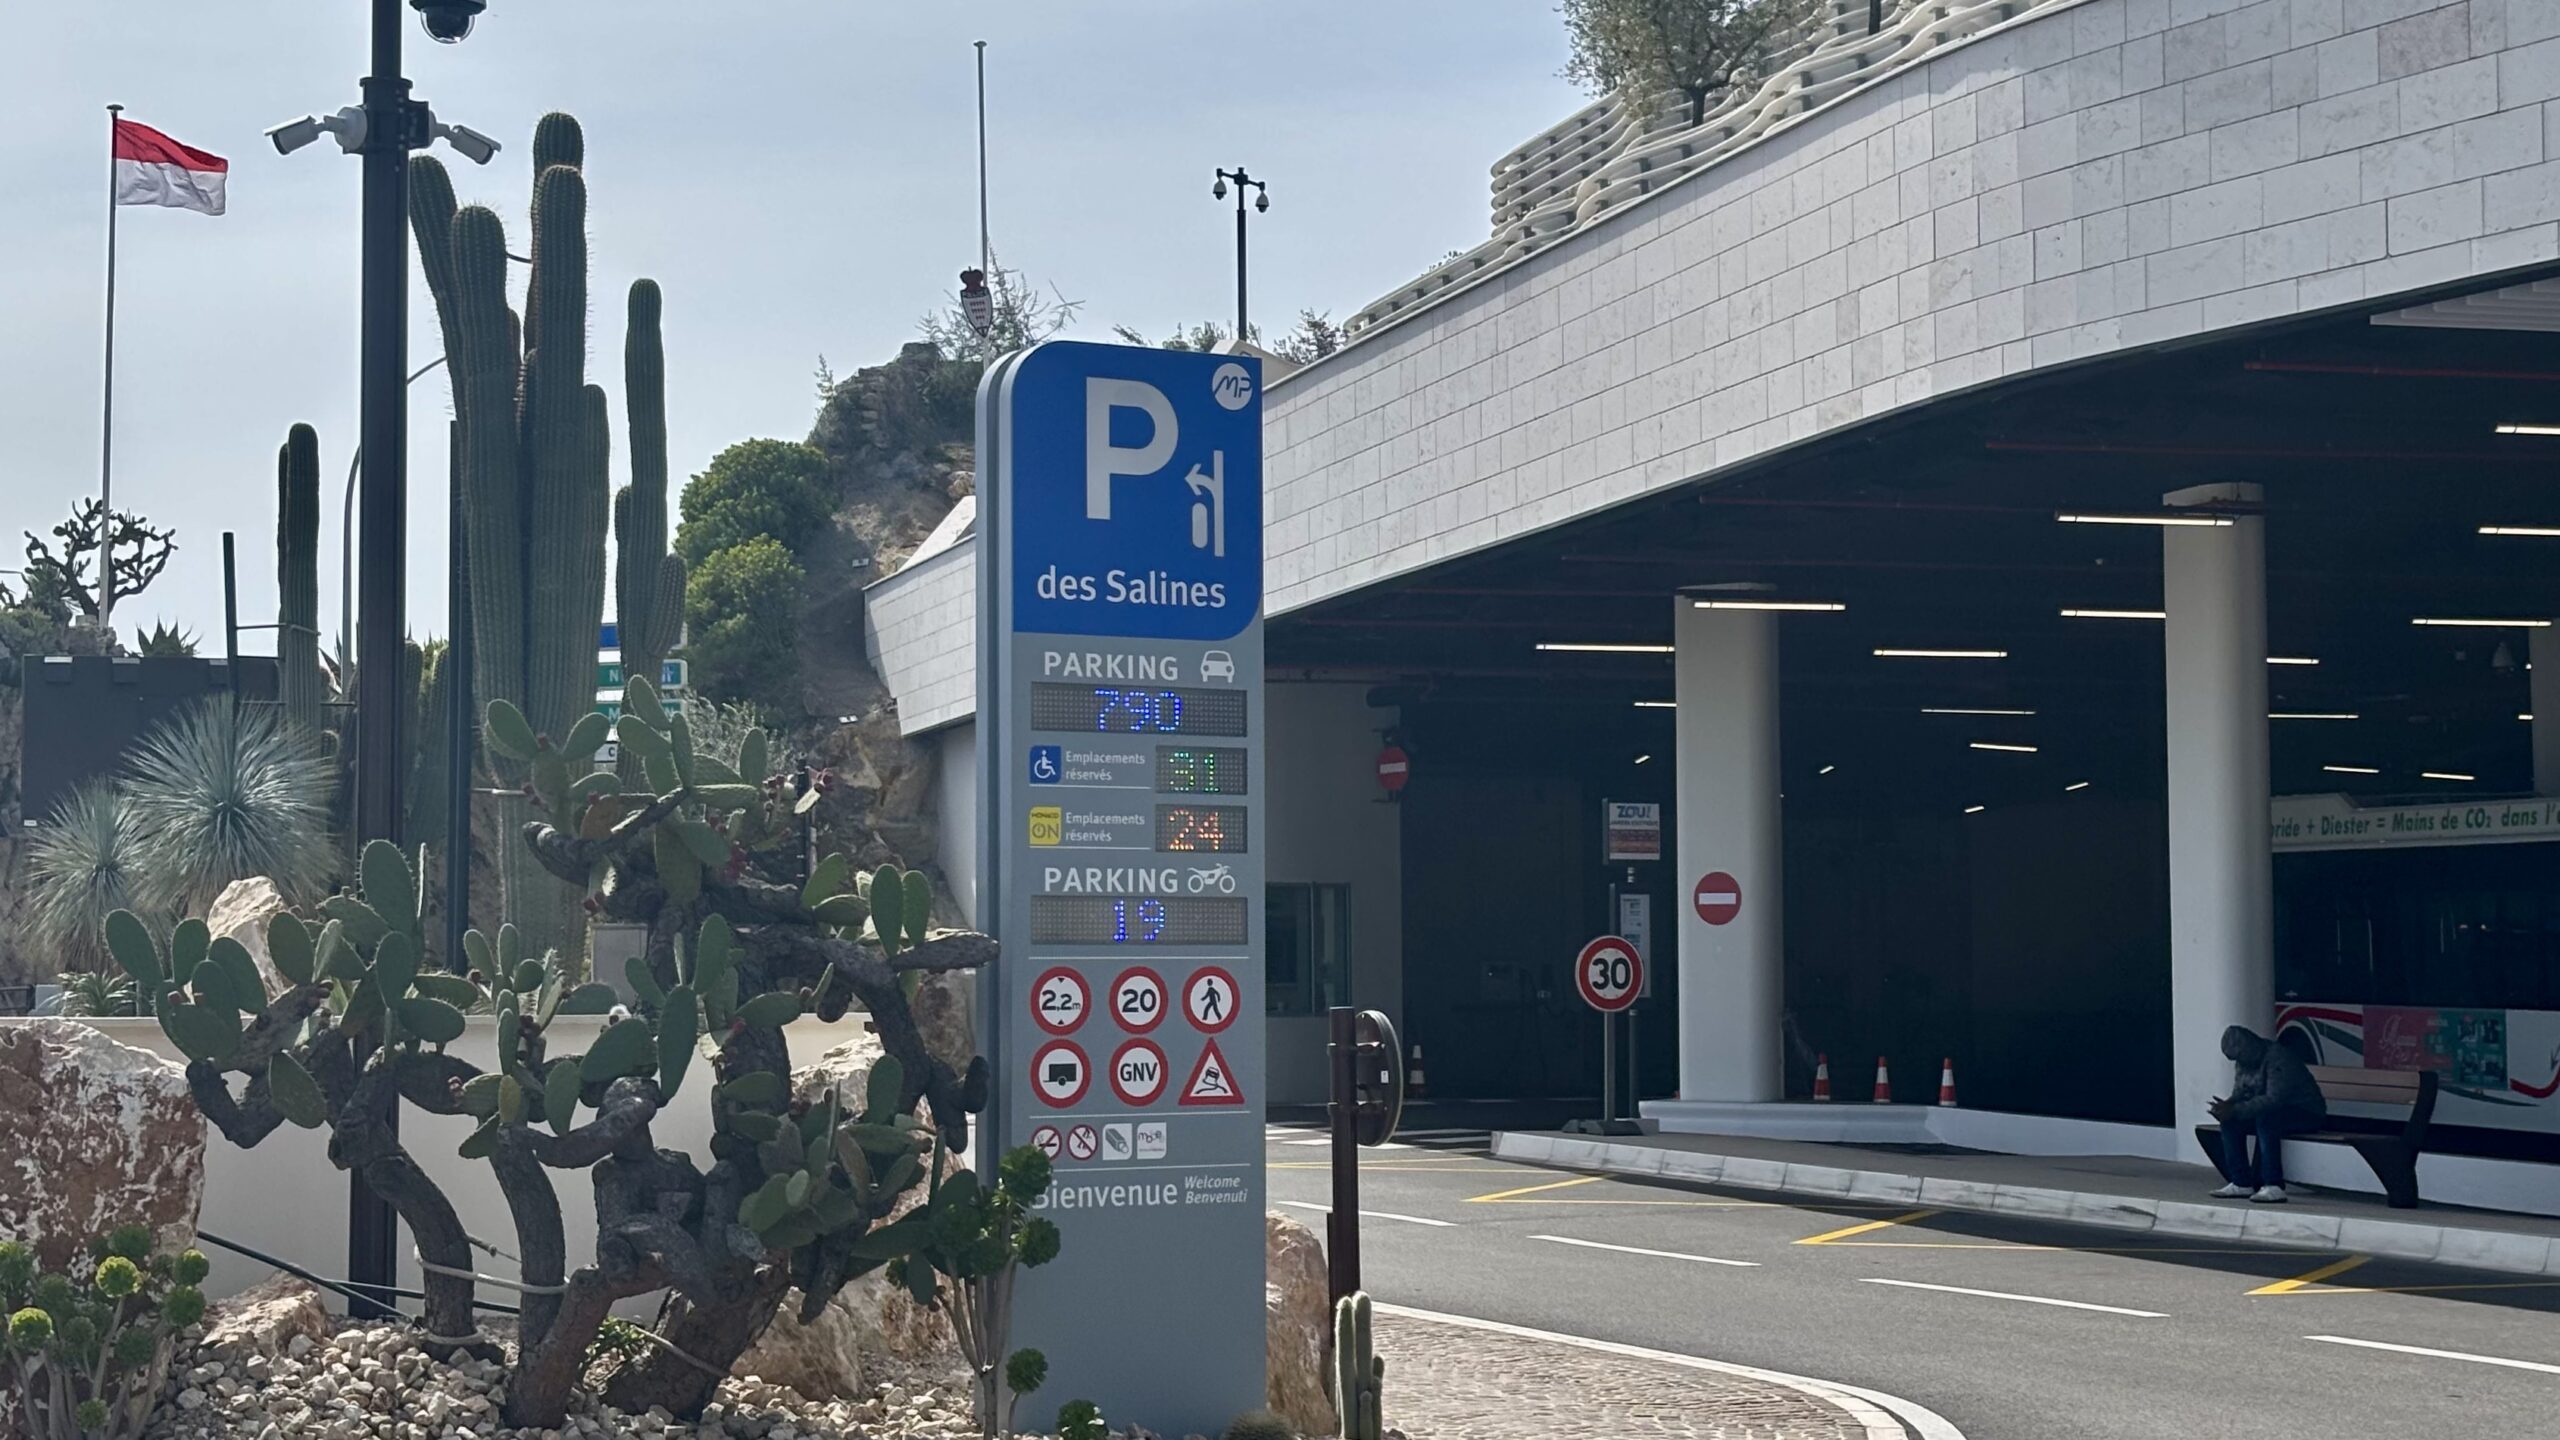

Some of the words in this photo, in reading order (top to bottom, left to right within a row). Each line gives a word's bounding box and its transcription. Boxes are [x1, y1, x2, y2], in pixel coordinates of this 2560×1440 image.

[1086, 376, 1179, 520] P
[1037, 564, 1096, 601] des
[1106, 569, 1226, 608] Salines
[1044, 651, 1179, 681] PARKING
[1094, 690, 1182, 732] 790
[1065, 751, 1145, 766] Emplacements
[1065, 768, 1112, 782] réservés
[1169, 752, 1220, 793] 31
[1031, 821, 1060, 840] ON
[1065, 812, 1145, 827] Emplacements
[1169, 810, 1224, 851] 24
[2321, 815, 2370, 836] Diester
[2441, 808, 2459, 830] de
[2502, 805, 2538, 827] dans
[2545, 803, 2560, 825] l'
[1065, 829, 1112, 842] réservés
[1044, 867, 1179, 894] PARKING
[1113, 899, 1166, 942] 19
[1591, 957, 1631, 990] 30
[1121, 988, 1157, 1013] 20
[1119, 1062, 1158, 1082] GNV
[1184, 1175, 1241, 1190] Welcome
[1185, 1188, 1248, 1205] Benvenuti
